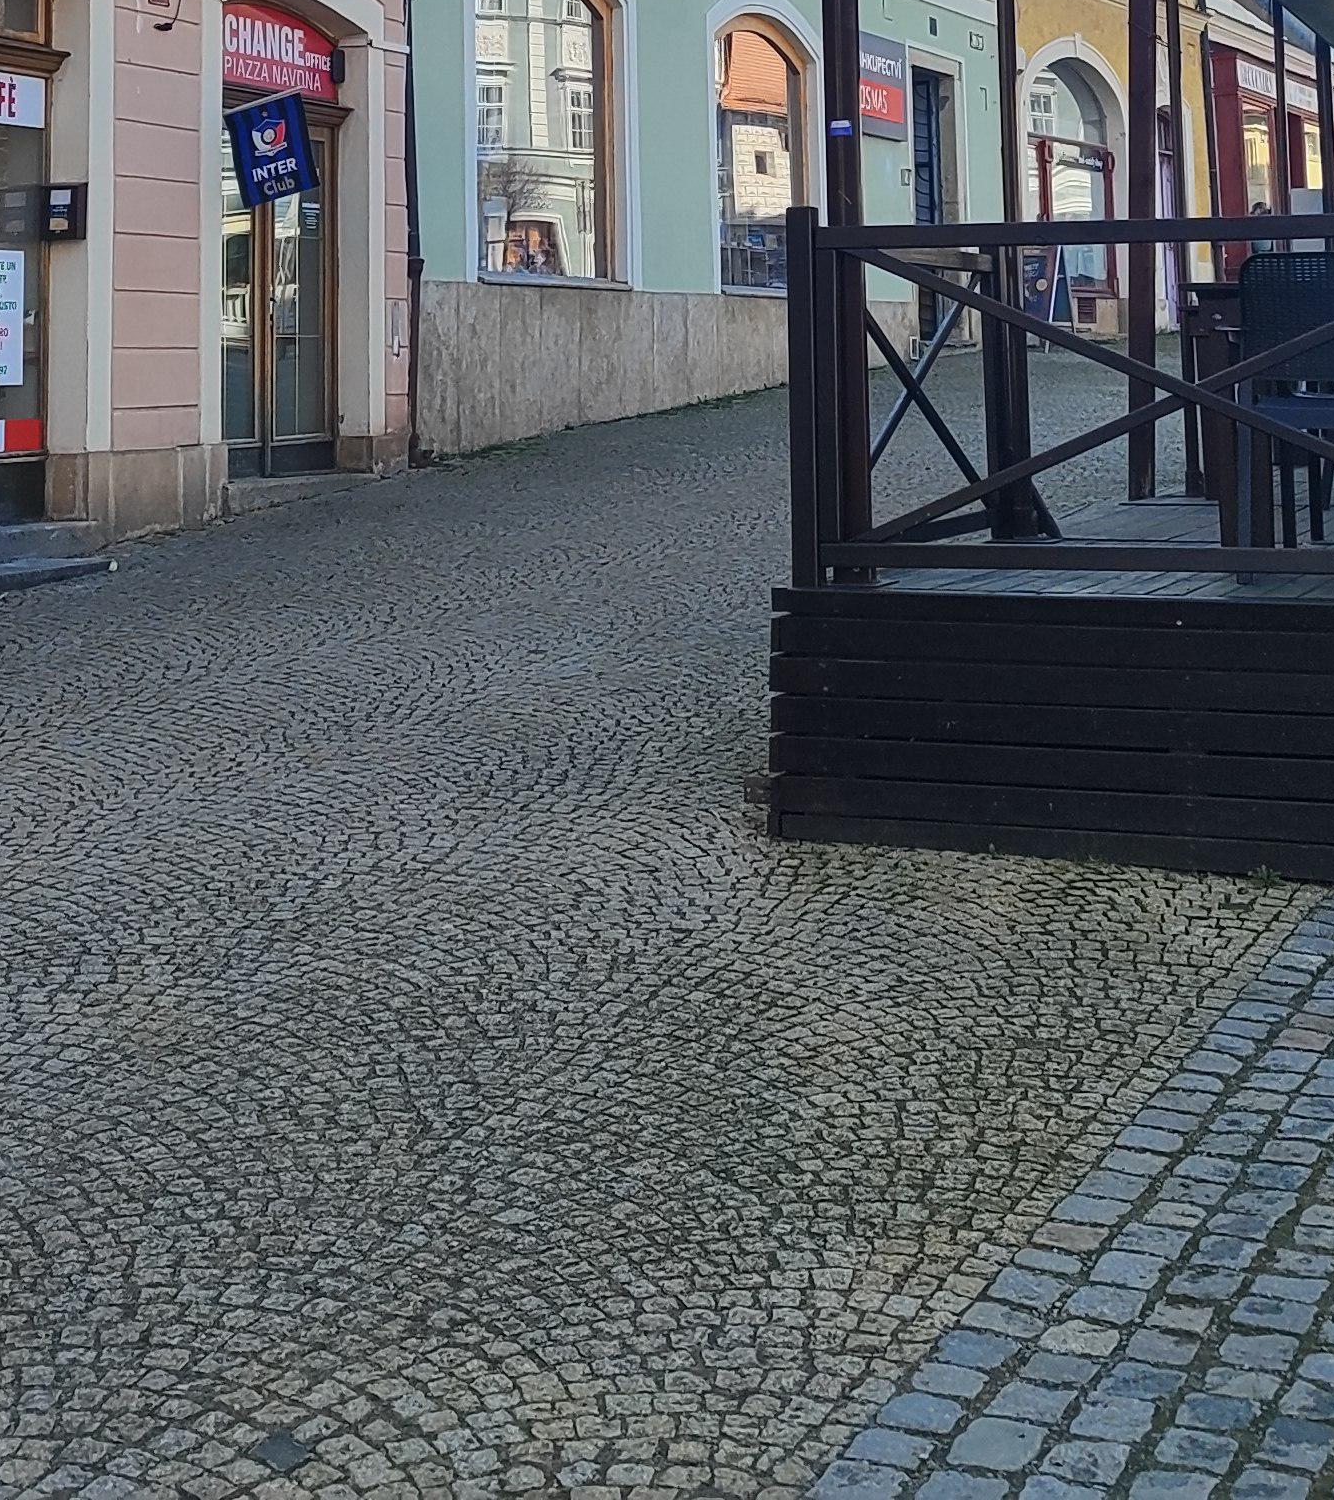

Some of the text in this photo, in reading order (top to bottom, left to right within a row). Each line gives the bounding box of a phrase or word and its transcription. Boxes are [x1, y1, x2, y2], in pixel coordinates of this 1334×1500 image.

[224, 13, 332, 71] CHANGE OFFICE
[224, 55, 322, 92] PIAZZA NAVONA
[252, 158, 298, 182] INTER
[263, 176, 296, 196] Club
